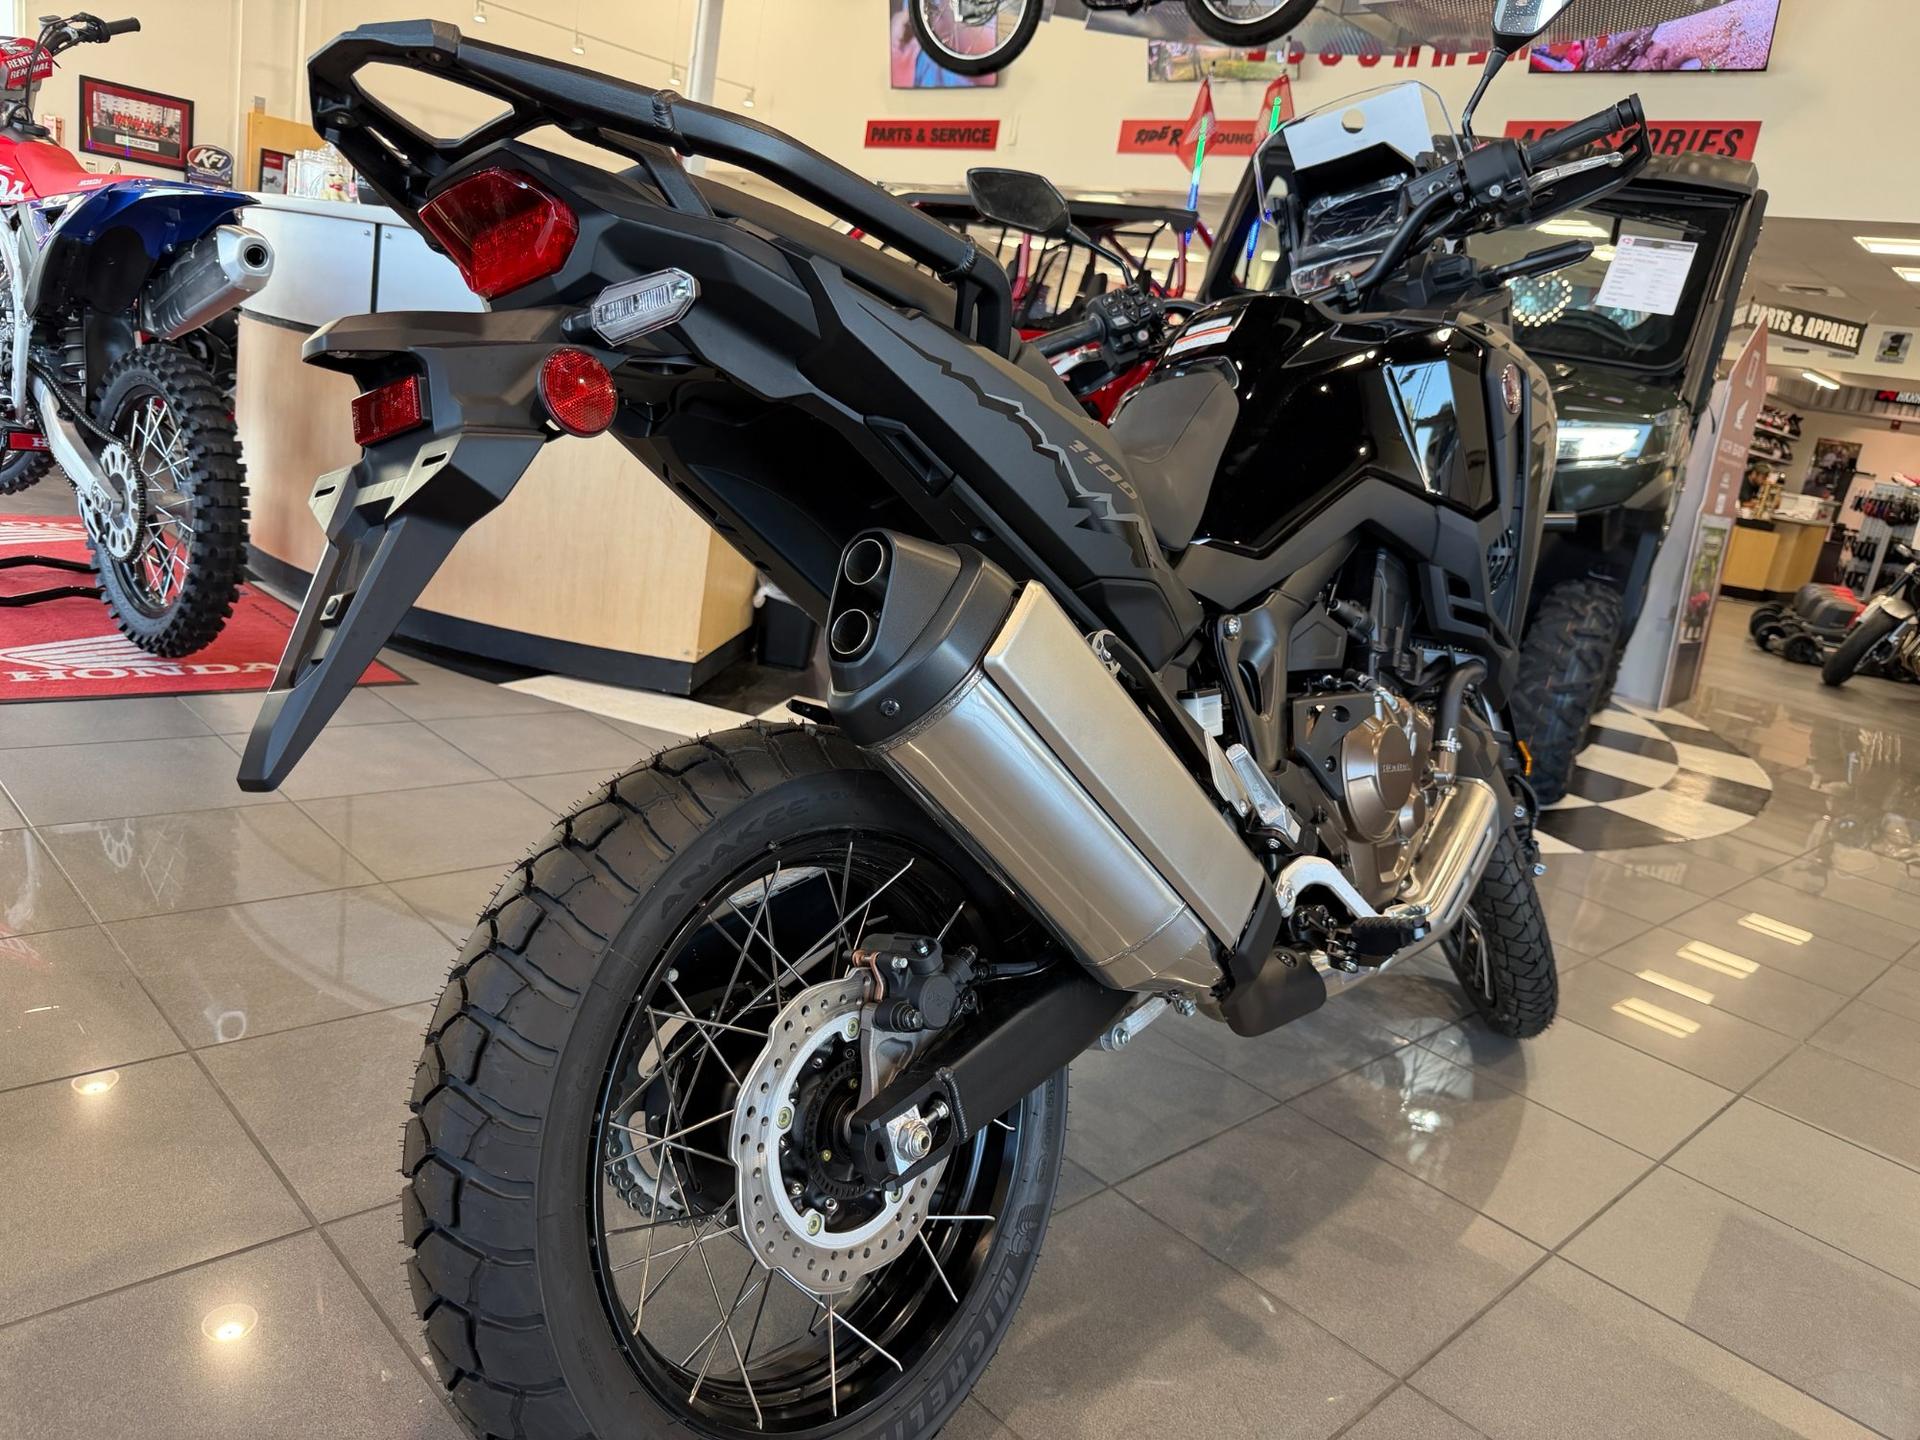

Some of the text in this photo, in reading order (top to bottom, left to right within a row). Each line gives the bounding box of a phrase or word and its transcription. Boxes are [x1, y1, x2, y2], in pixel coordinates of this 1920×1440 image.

[7, 51, 49, 69] RENTAL
[10, 62, 50, 80] RENHAL
[871, 127, 992, 143] PARTS & SERVICE
[1748, 303, 1793, 332] PARTS
[1790, 314, 1804, 335] &
[1803, 317, 1860, 348] APPAREL
[4, 662, 278, 682] HONDA
[880, 1267, 1018, 1440] MICHELI
